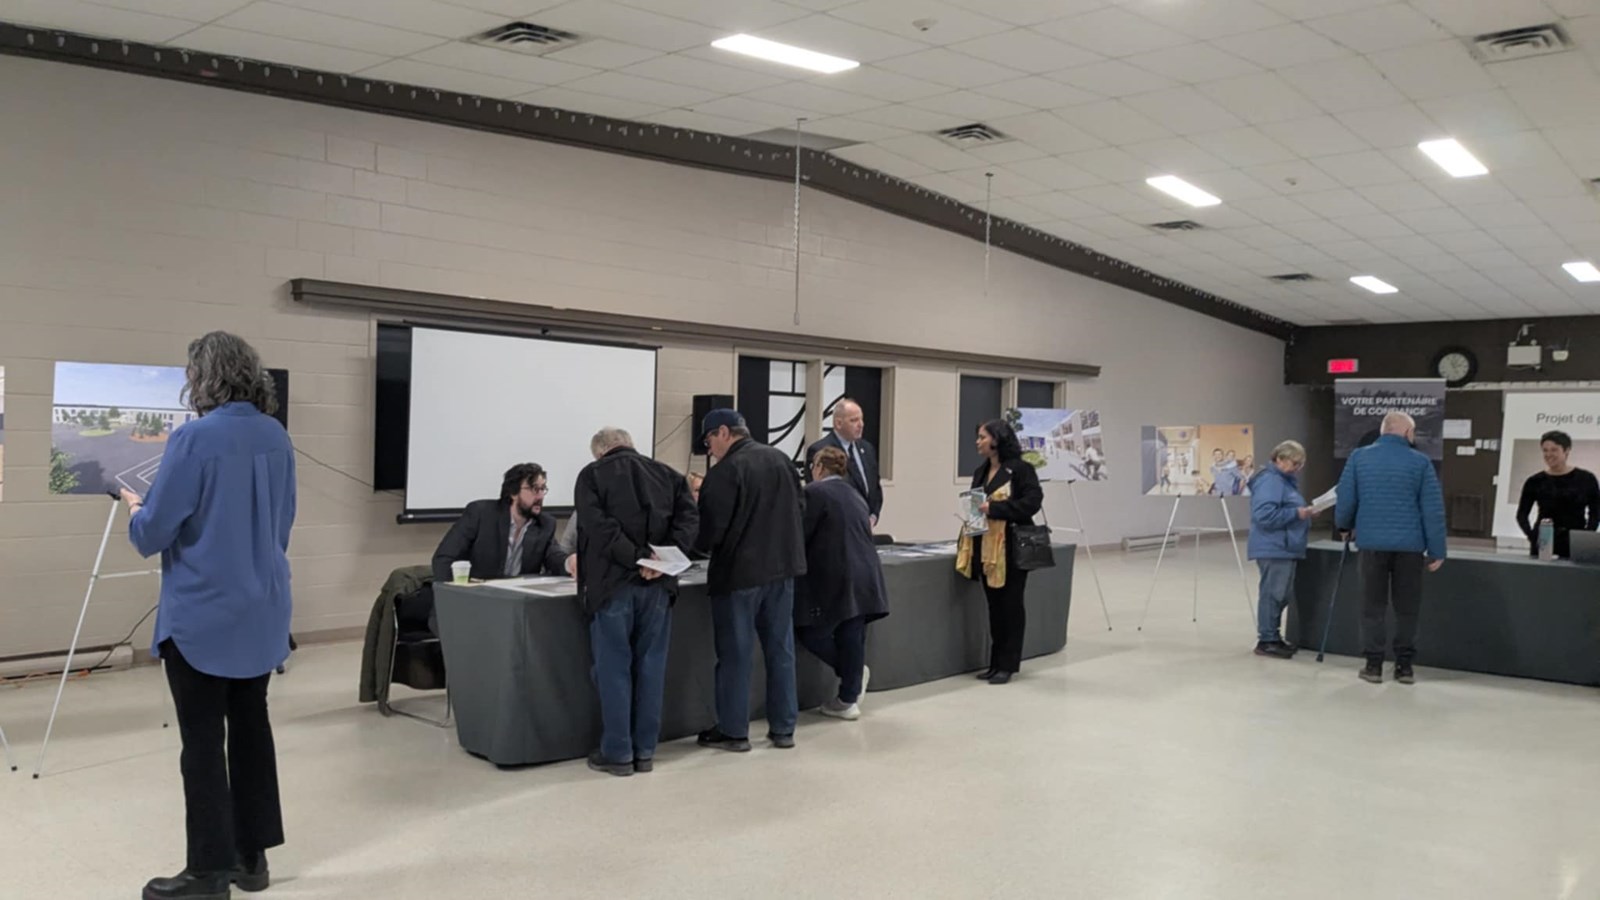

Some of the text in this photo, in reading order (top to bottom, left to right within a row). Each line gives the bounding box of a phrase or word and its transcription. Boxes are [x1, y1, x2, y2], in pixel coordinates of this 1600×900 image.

[1341, 397, 1437, 406] VOTRE PARTENAIRE
[1353, 407, 1366, 415] DE
[1536, 412, 1573, 426] Projet
[1576, 413, 1593, 424] de
